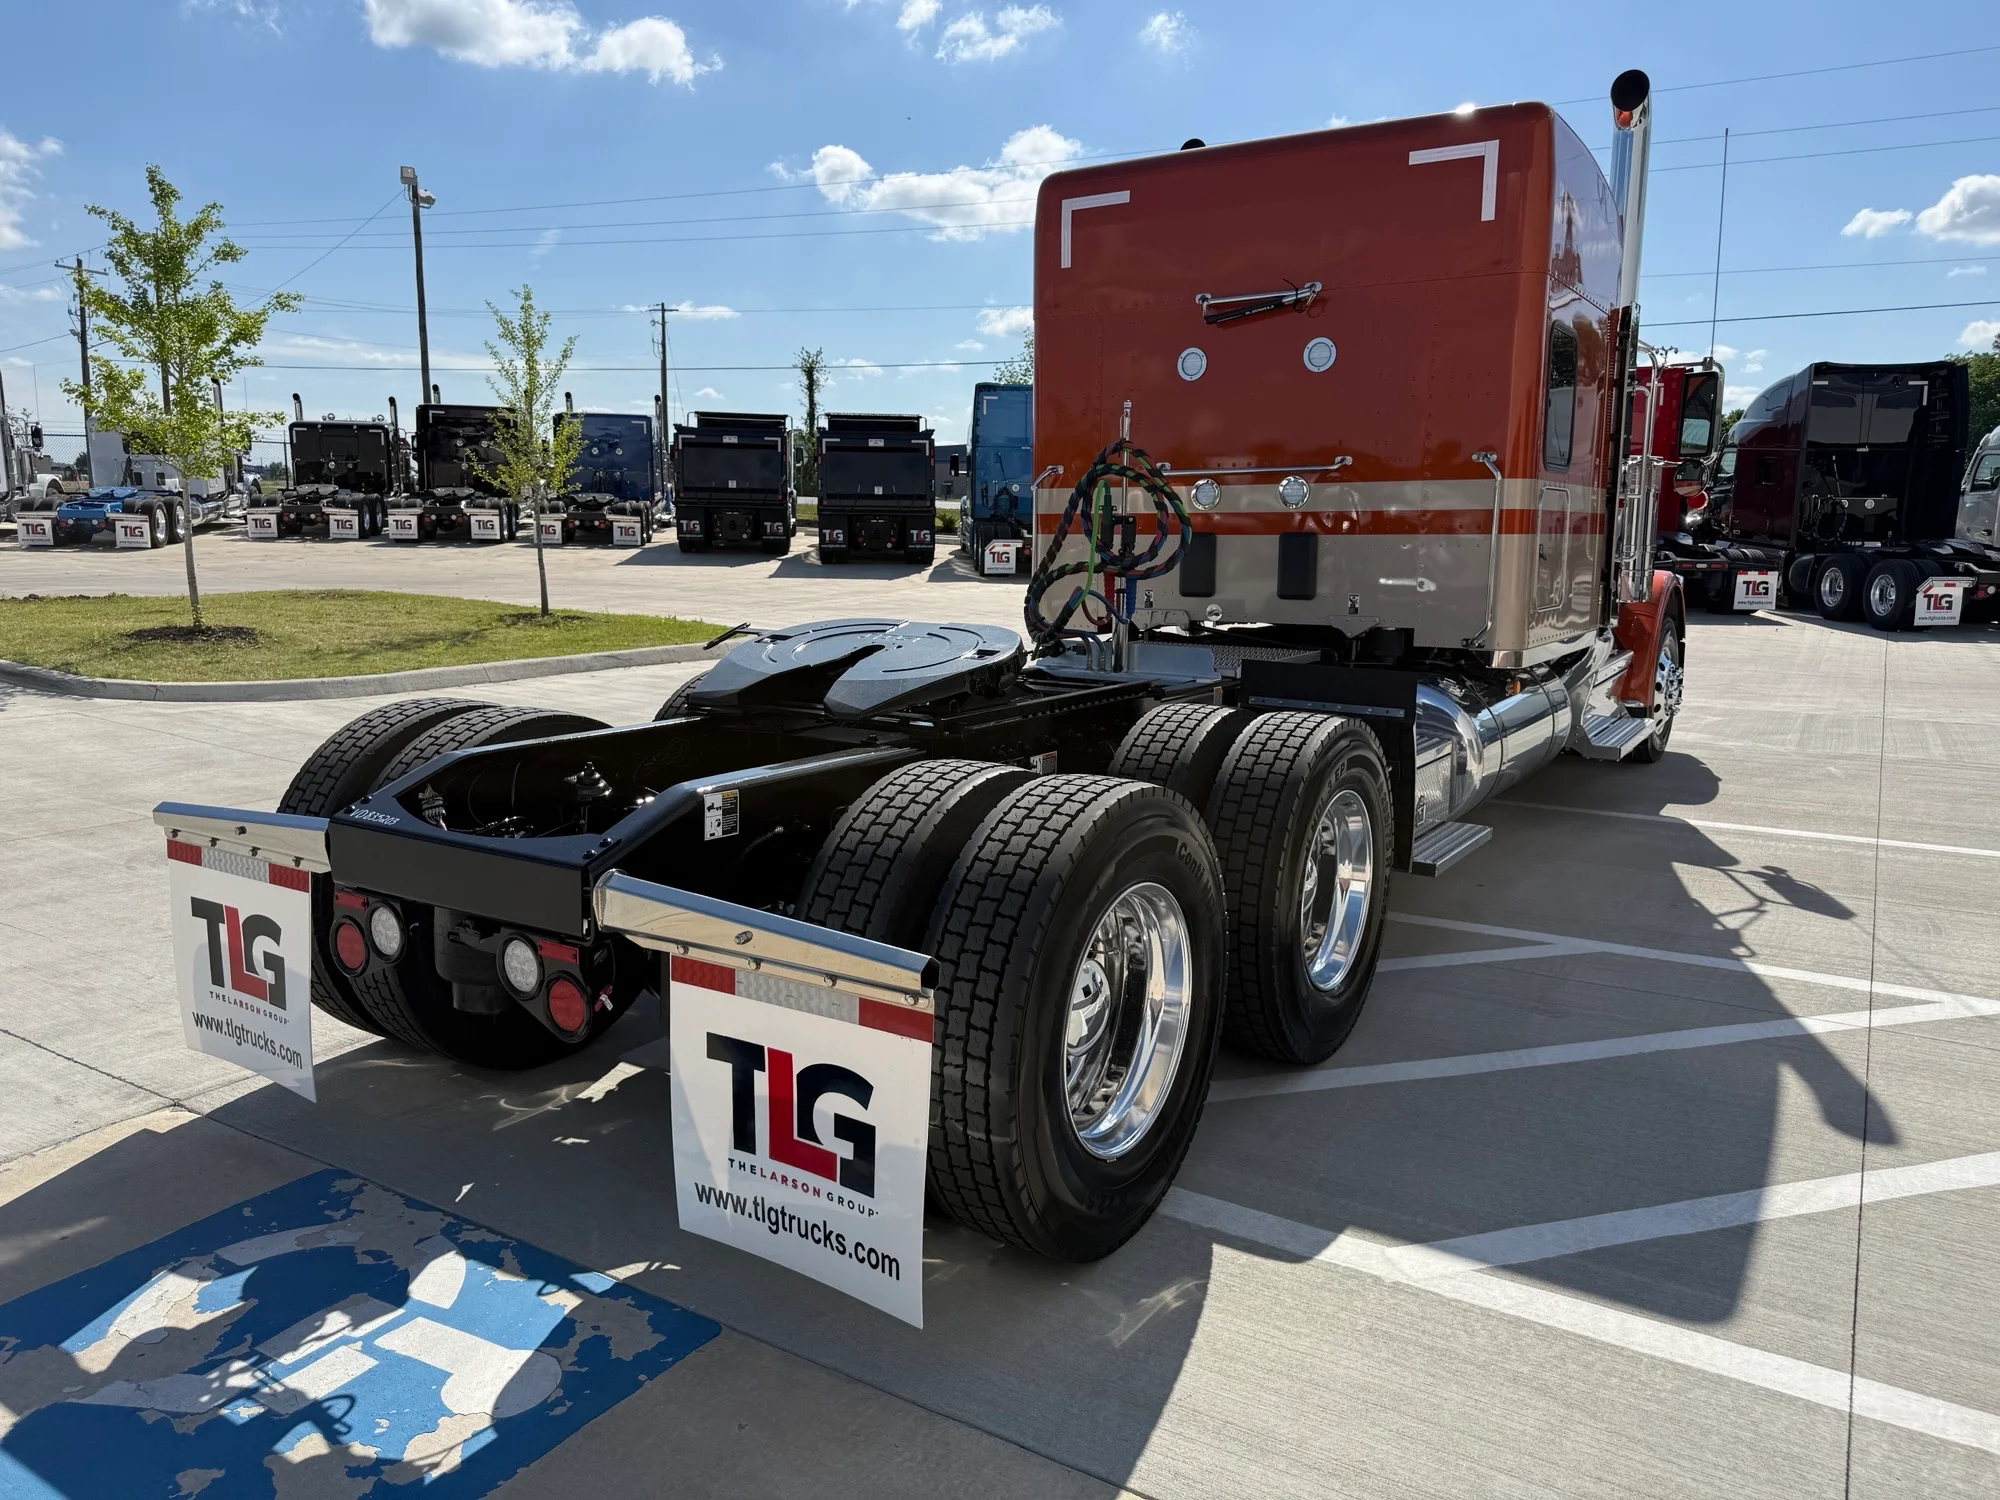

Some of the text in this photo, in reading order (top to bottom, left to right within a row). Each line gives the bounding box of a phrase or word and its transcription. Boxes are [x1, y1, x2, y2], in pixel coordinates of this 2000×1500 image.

[22, 523, 47, 535] TLG
[252, 519, 271, 529] TLG
[334, 520, 353, 530] TLG
[393, 520, 412, 530] TLG
[475, 520, 494, 530] TLG
[680, 520, 700, 532] TLG
[764, 522, 783, 533] TLG
[121, 525, 144, 537] TLG
[617, 526, 635, 536] TLG
[823, 529, 843, 541] TLG
[910, 530, 931, 541] TLG
[990, 552, 1010, 563] TLG
[1743, 581, 1769, 595] TLG
[1923, 594, 1953, 610] TLG
[1178, 842, 1205, 880] Conti
[191, 896, 287, 1011] TLG
[262, 1009, 290, 1025] GROUP
[192, 1011, 303, 1069] www.tlgtrucks.com
[706, 1031, 877, 1199] TLG
[826, 1191, 878, 1218] GROUP
[694, 1182, 901, 1281] www.tlgtrucks.com
